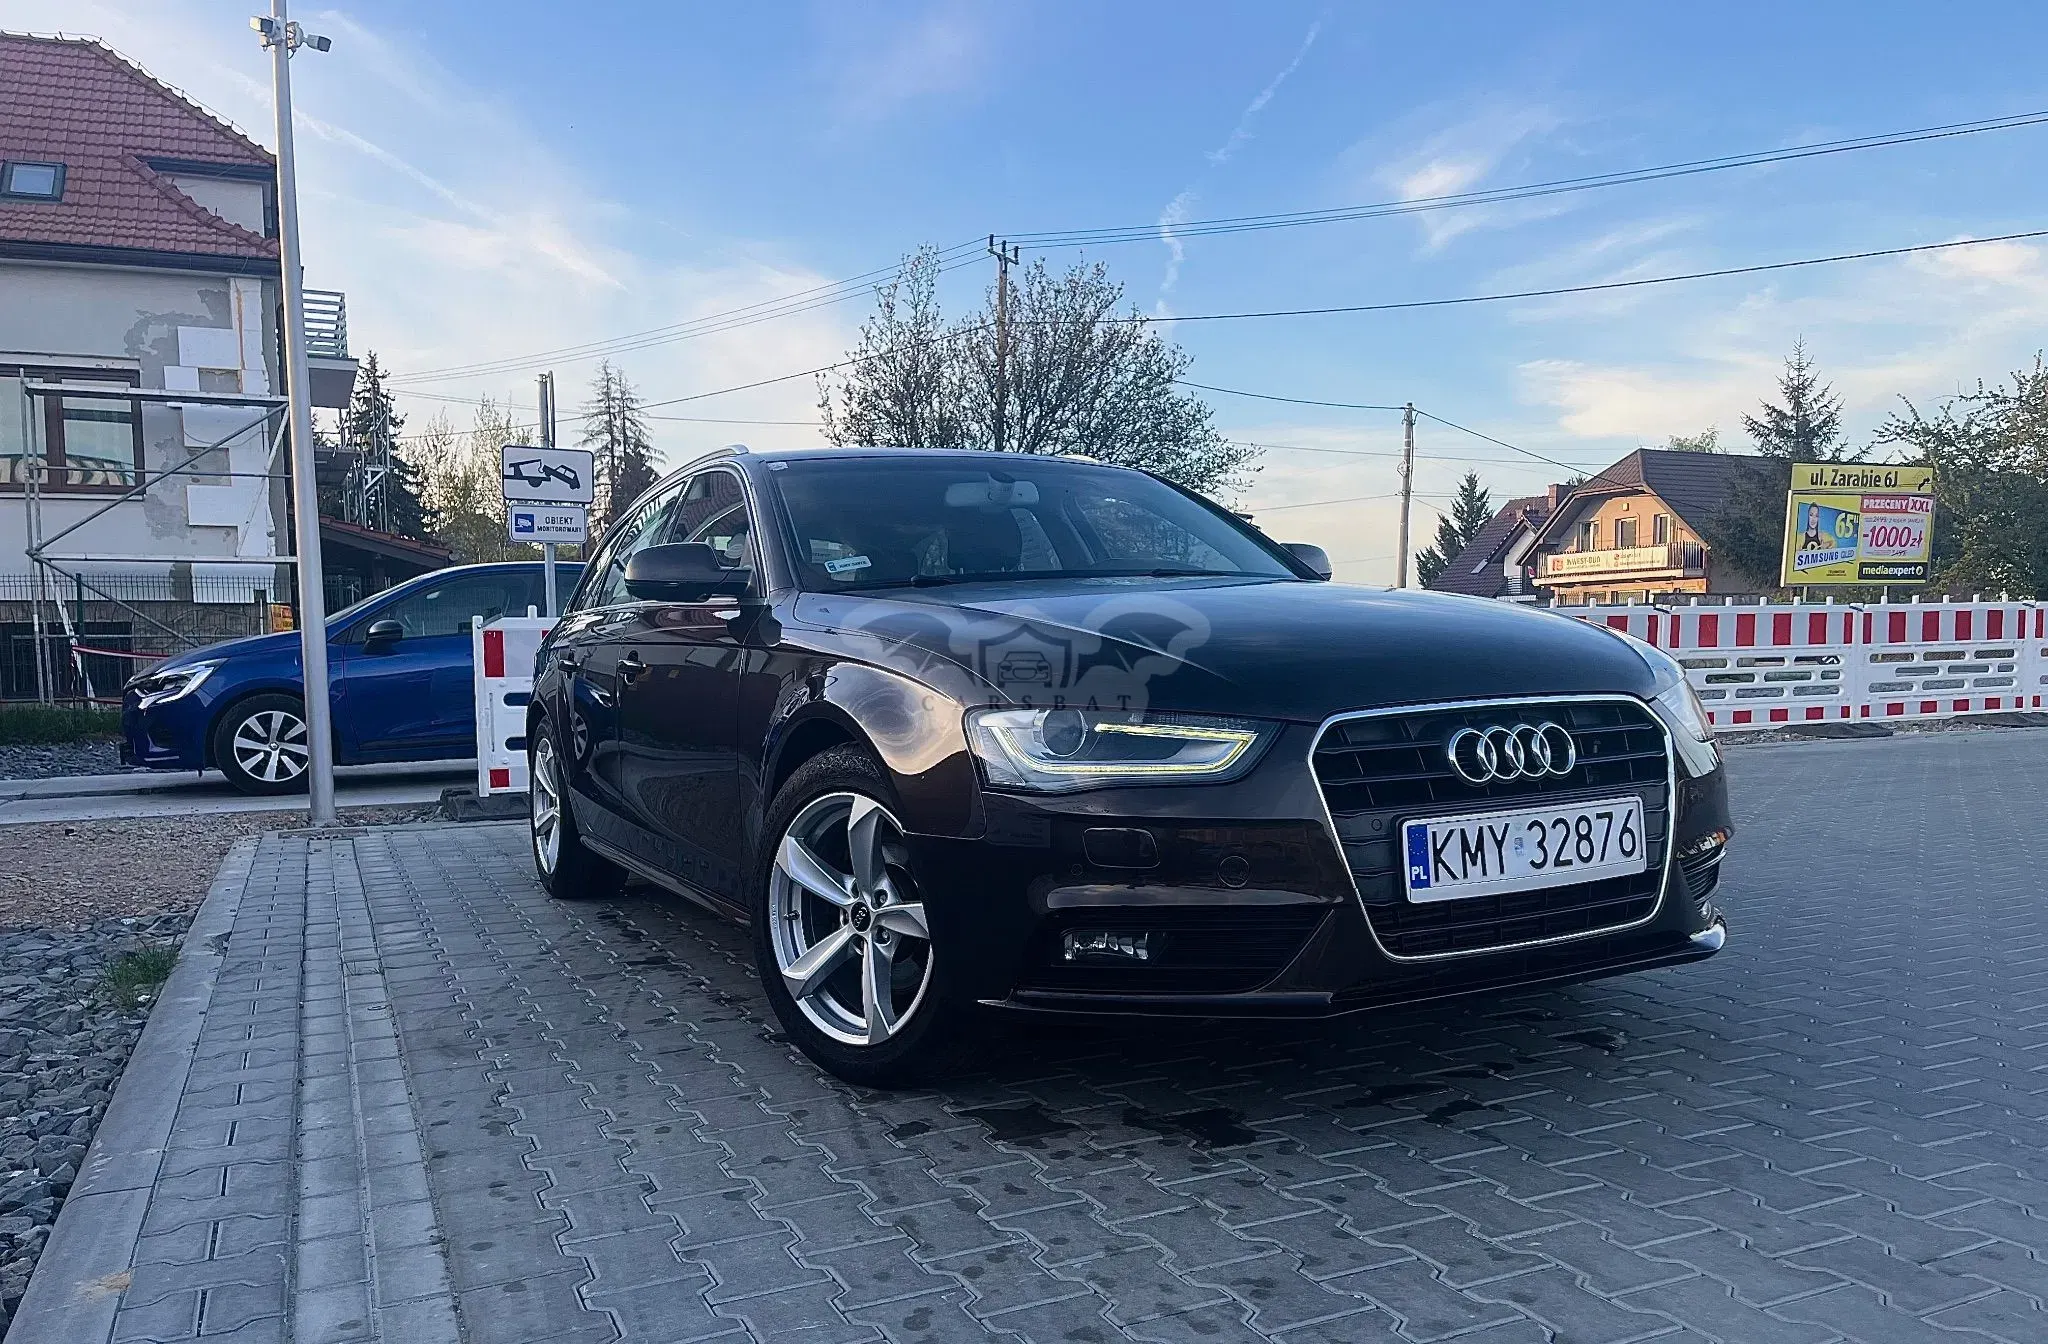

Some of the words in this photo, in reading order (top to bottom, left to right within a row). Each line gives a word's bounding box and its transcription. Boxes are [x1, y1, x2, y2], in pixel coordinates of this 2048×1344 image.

[1810, 468, 1827, 486] ul.
[1830, 468, 1881, 488] Zarabie
[1863, 499, 1908, 510] PRZECENY
[1909, 499, 1930, 512] XXL
[544, 516, 574, 525] OBIEKT
[1797, 551, 1839, 566] SAMSUNG
[1862, 566, 1915, 576] mediaexpert
[1411, 865, 1428, 881] PL
[1431, 822, 1511, 883] KMY
[1526, 808, 1637, 870] 32876
